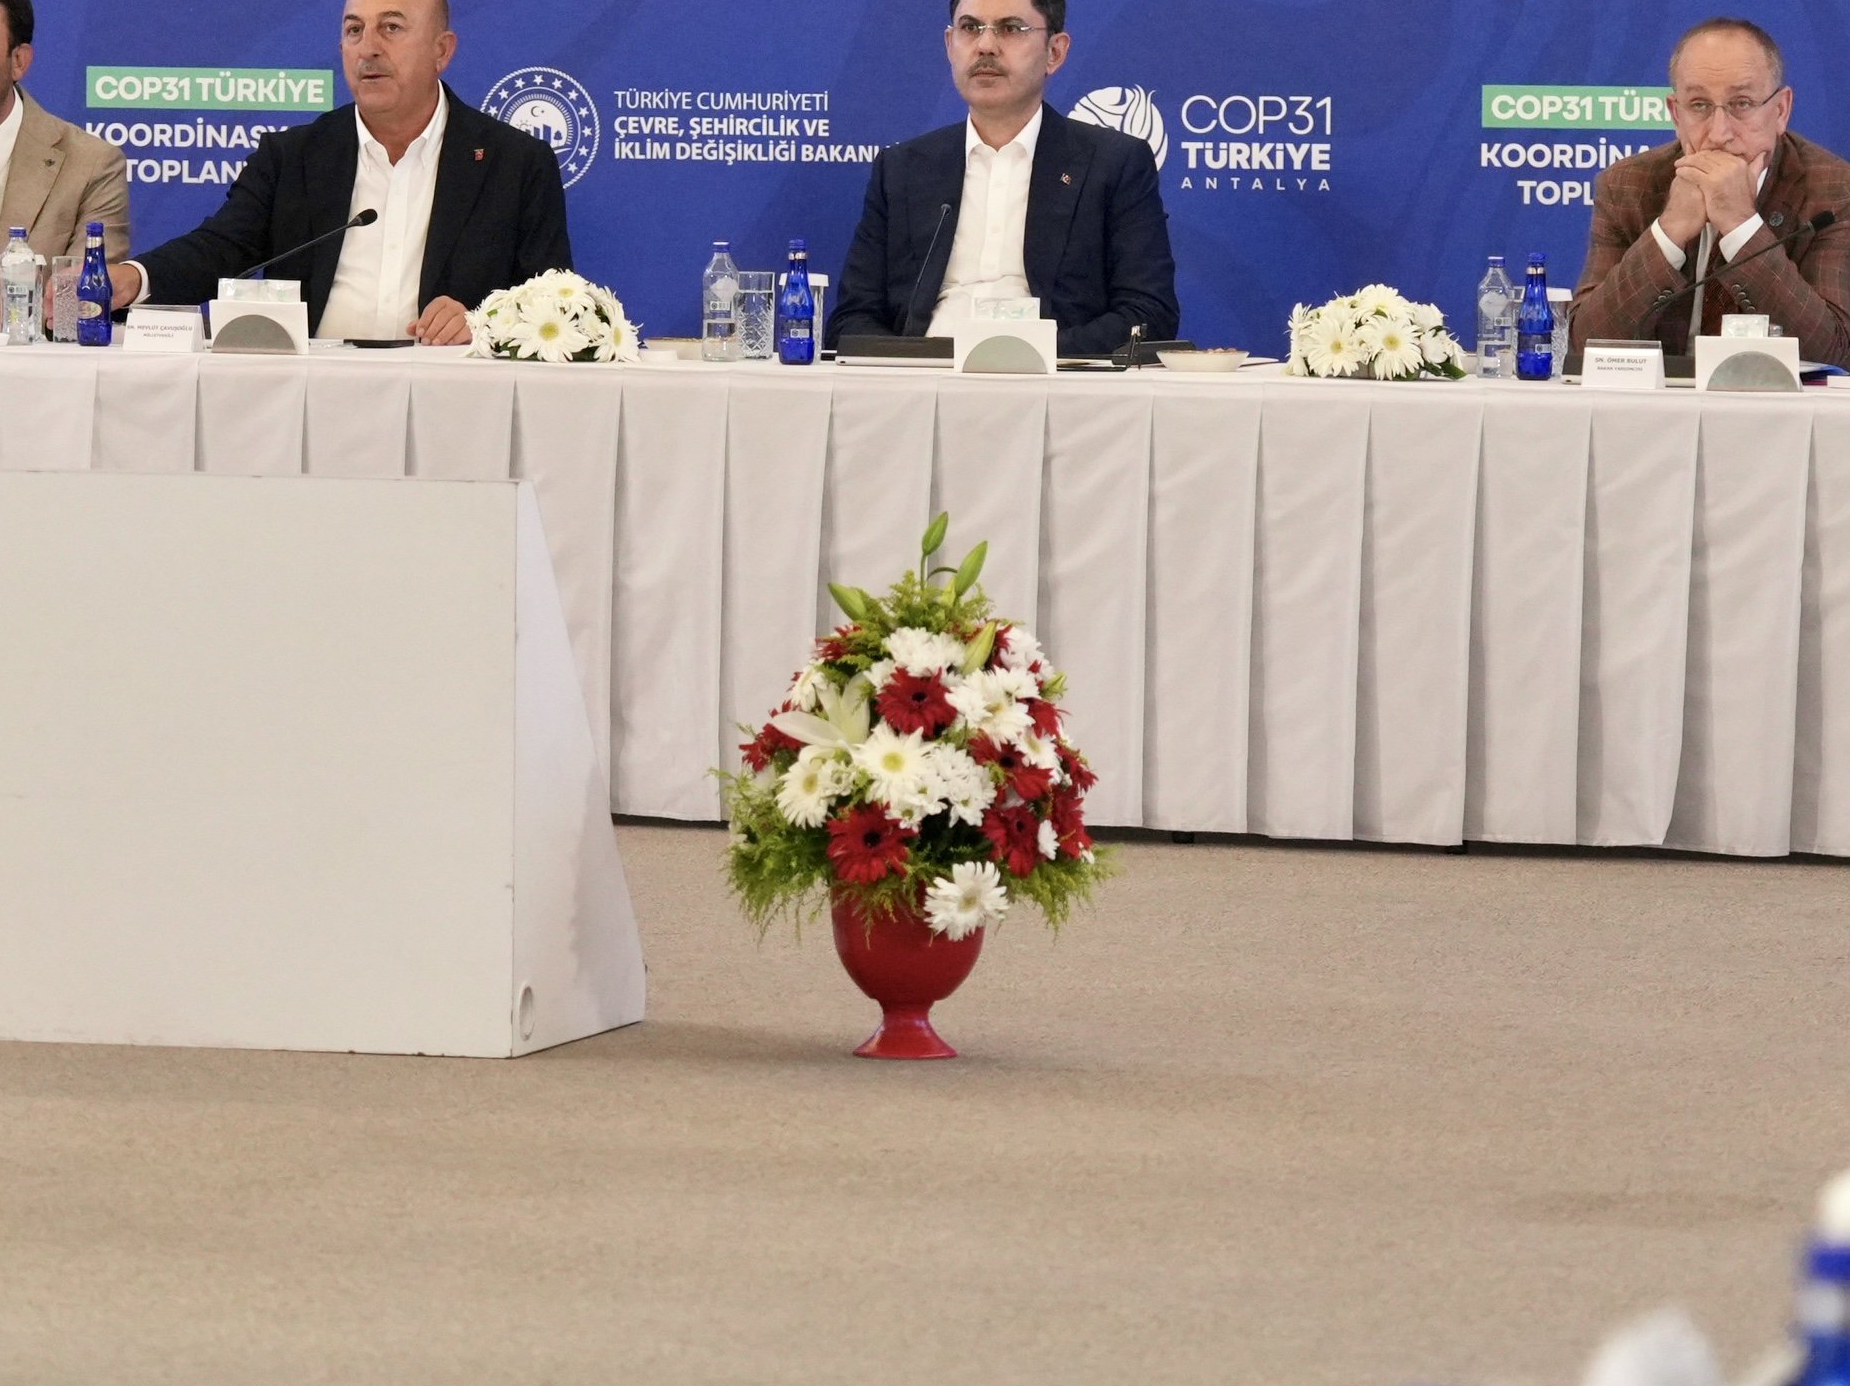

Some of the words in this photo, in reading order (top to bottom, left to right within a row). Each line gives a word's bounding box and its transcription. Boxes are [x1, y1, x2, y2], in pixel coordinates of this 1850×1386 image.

[96, 76, 190, 100] COP31
[196, 71, 324, 103] TÜRKİYE
[614, 88, 691, 109] TÜRKİYE
[697, 91, 828, 111] CUMHURİYETİ
[1182, 95, 1331, 134] COP31
[1492, 95, 1592, 120] COP31
[85, 117, 288, 149] KOORDİNAS
[615, 117, 684, 138] ÇEVRE,
[690, 115, 799, 139] ŞEHİRCİLİK
[803, 119, 829, 136] VE
[615, 140, 670, 159] İKLİM
[676, 140, 795, 165] DEĞİŞİKLİĞİ
[1181, 142, 1330, 170] TÜRKİYE
[1481, 138, 1649, 169] KOORDİN
[124, 159, 246, 184] TOPLAN
[1181, 177, 1329, 190] ANTALYA
